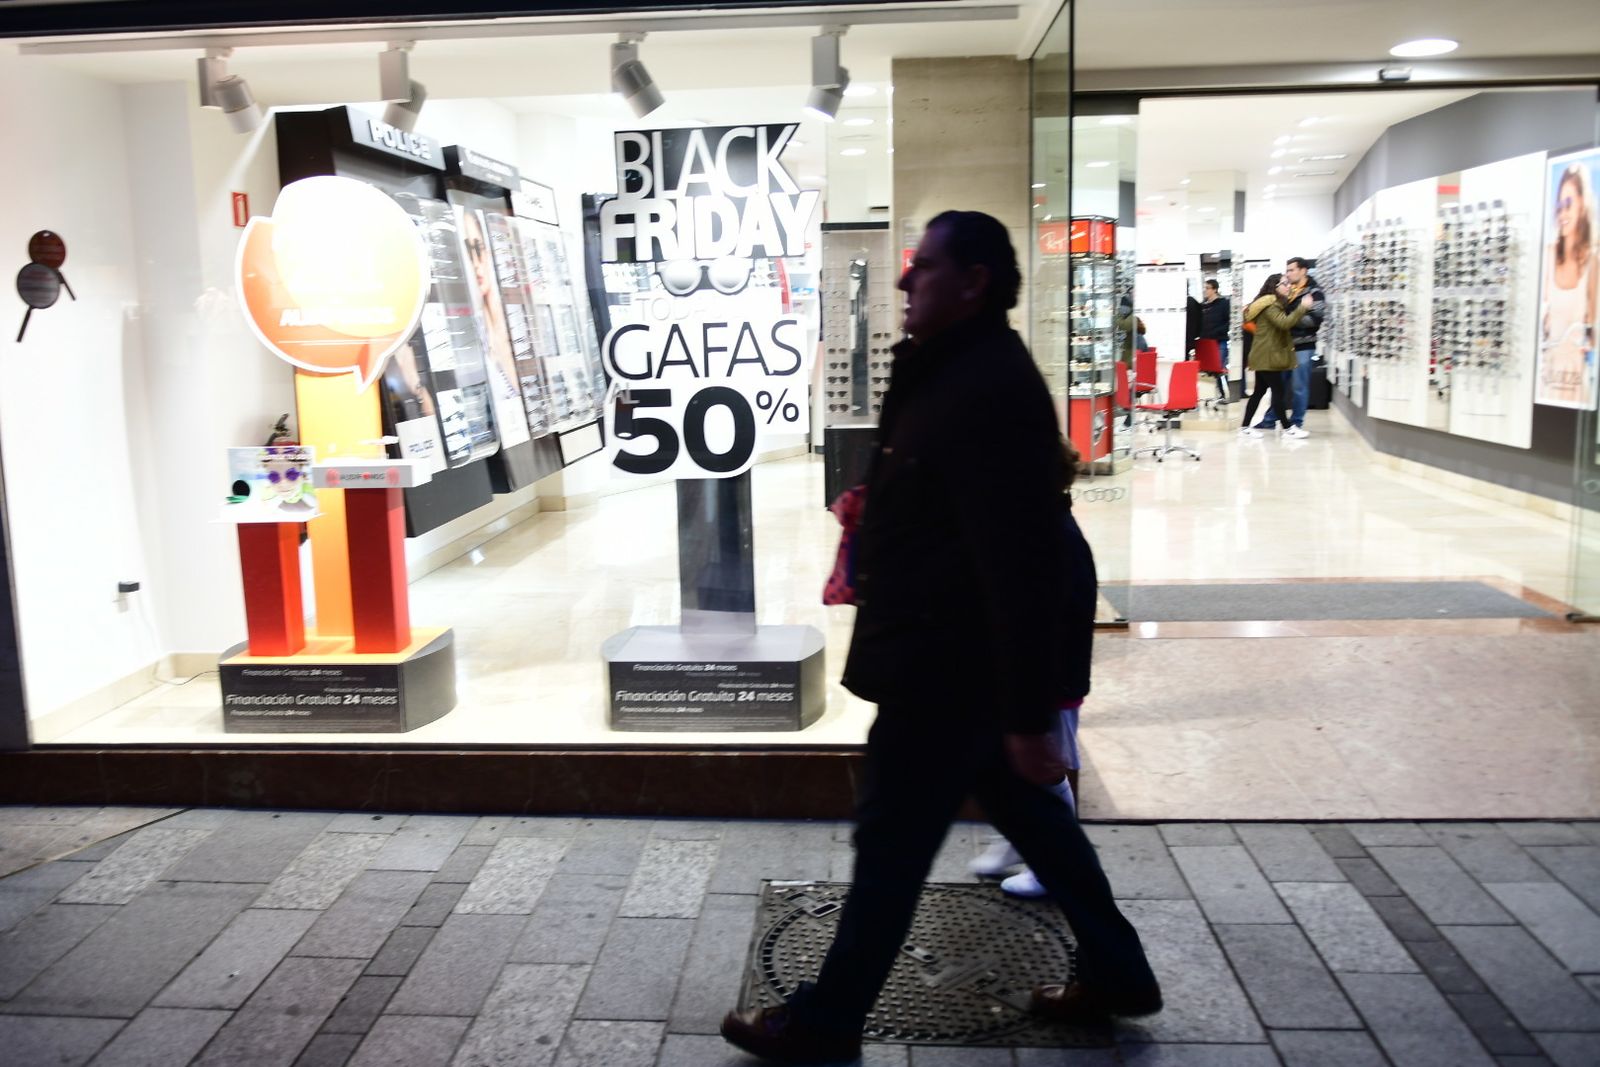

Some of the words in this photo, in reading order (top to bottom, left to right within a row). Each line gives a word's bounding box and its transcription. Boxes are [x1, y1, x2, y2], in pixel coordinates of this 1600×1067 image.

[367, 119, 433, 160] POLICE
[616, 123, 800, 199] BLACK
[601, 190, 820, 262] FRIDAY
[608, 319, 802, 380] GAFAS
[224, 692, 295, 705] Financiación
[342, 694, 361, 705] 24
[361, 695, 398, 705] meses
[614, 689, 687, 702] Financiación
[737, 690, 756, 702] 24
[756, 692, 794, 702] meses
